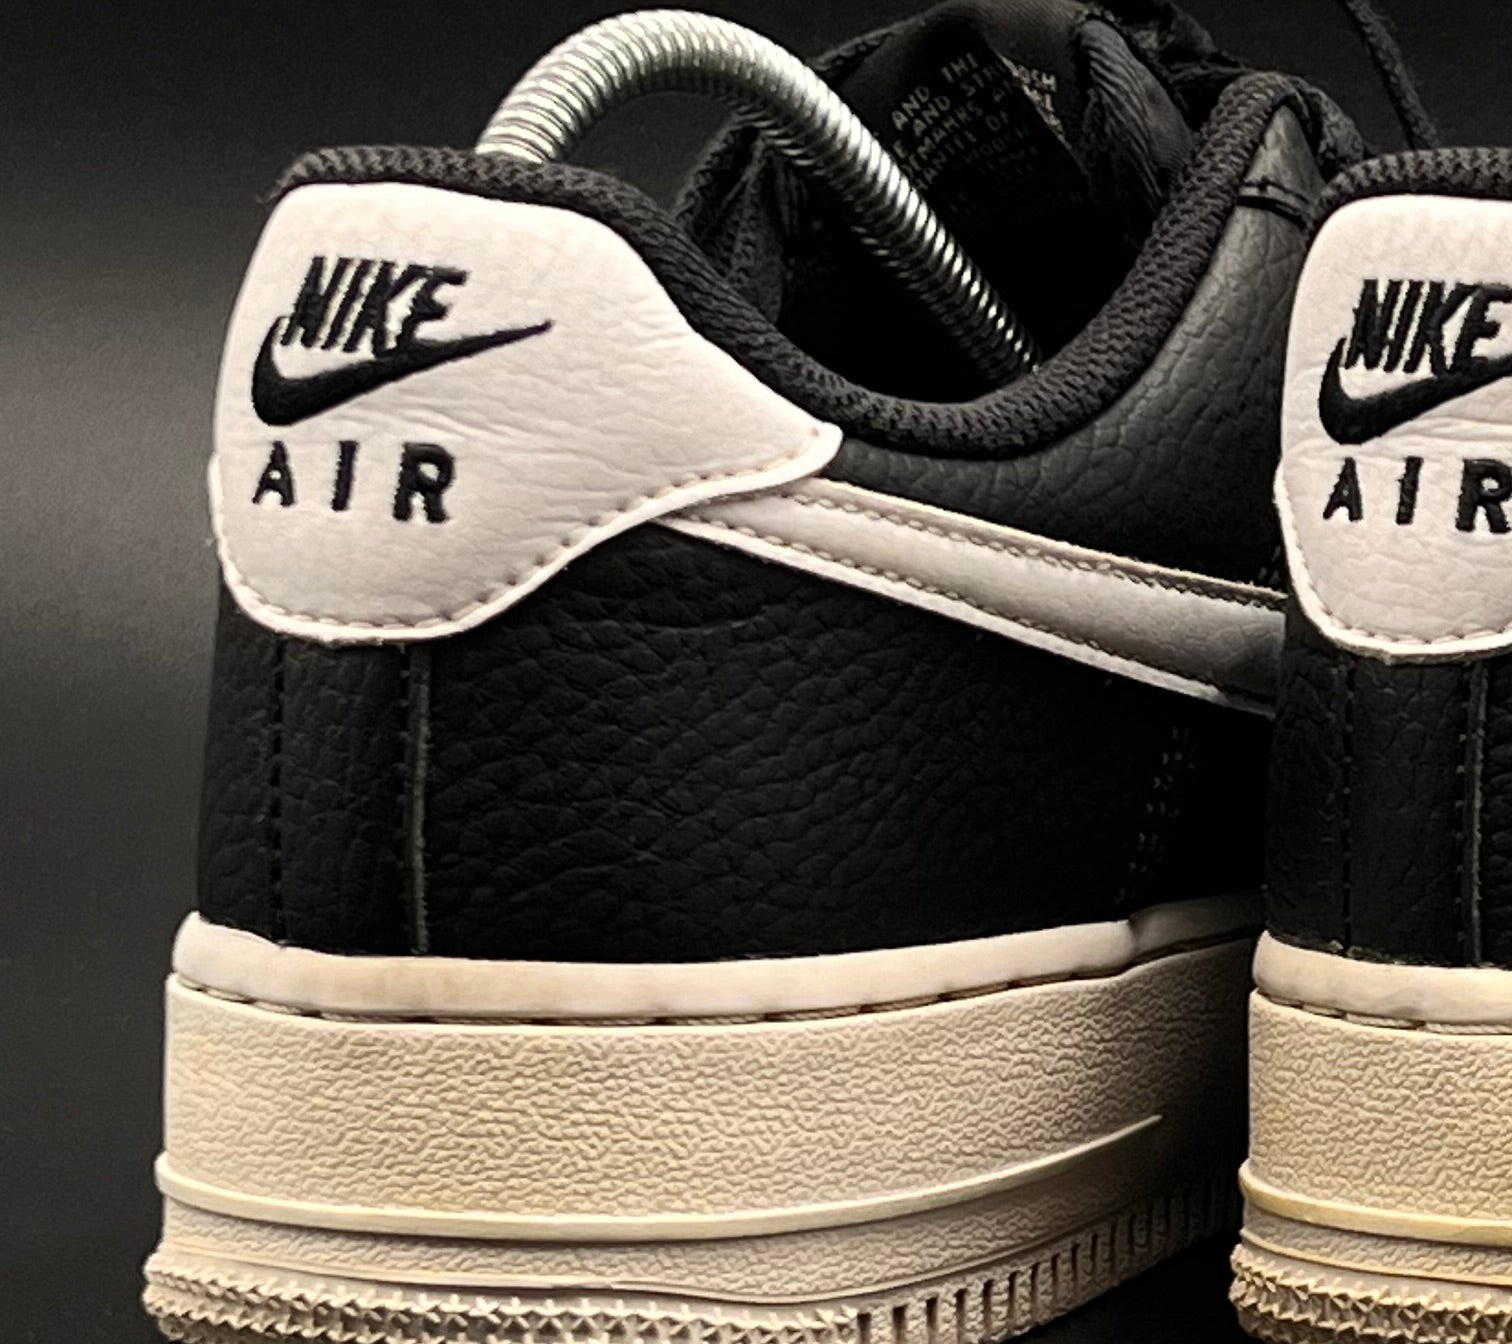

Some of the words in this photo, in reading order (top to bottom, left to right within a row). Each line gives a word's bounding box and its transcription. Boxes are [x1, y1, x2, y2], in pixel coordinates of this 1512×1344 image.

[891, 86, 930, 131] AND
[912, 95, 951, 137] AND
[280, 256, 469, 360] NIKE
[252, 440, 454, 523] AIR
